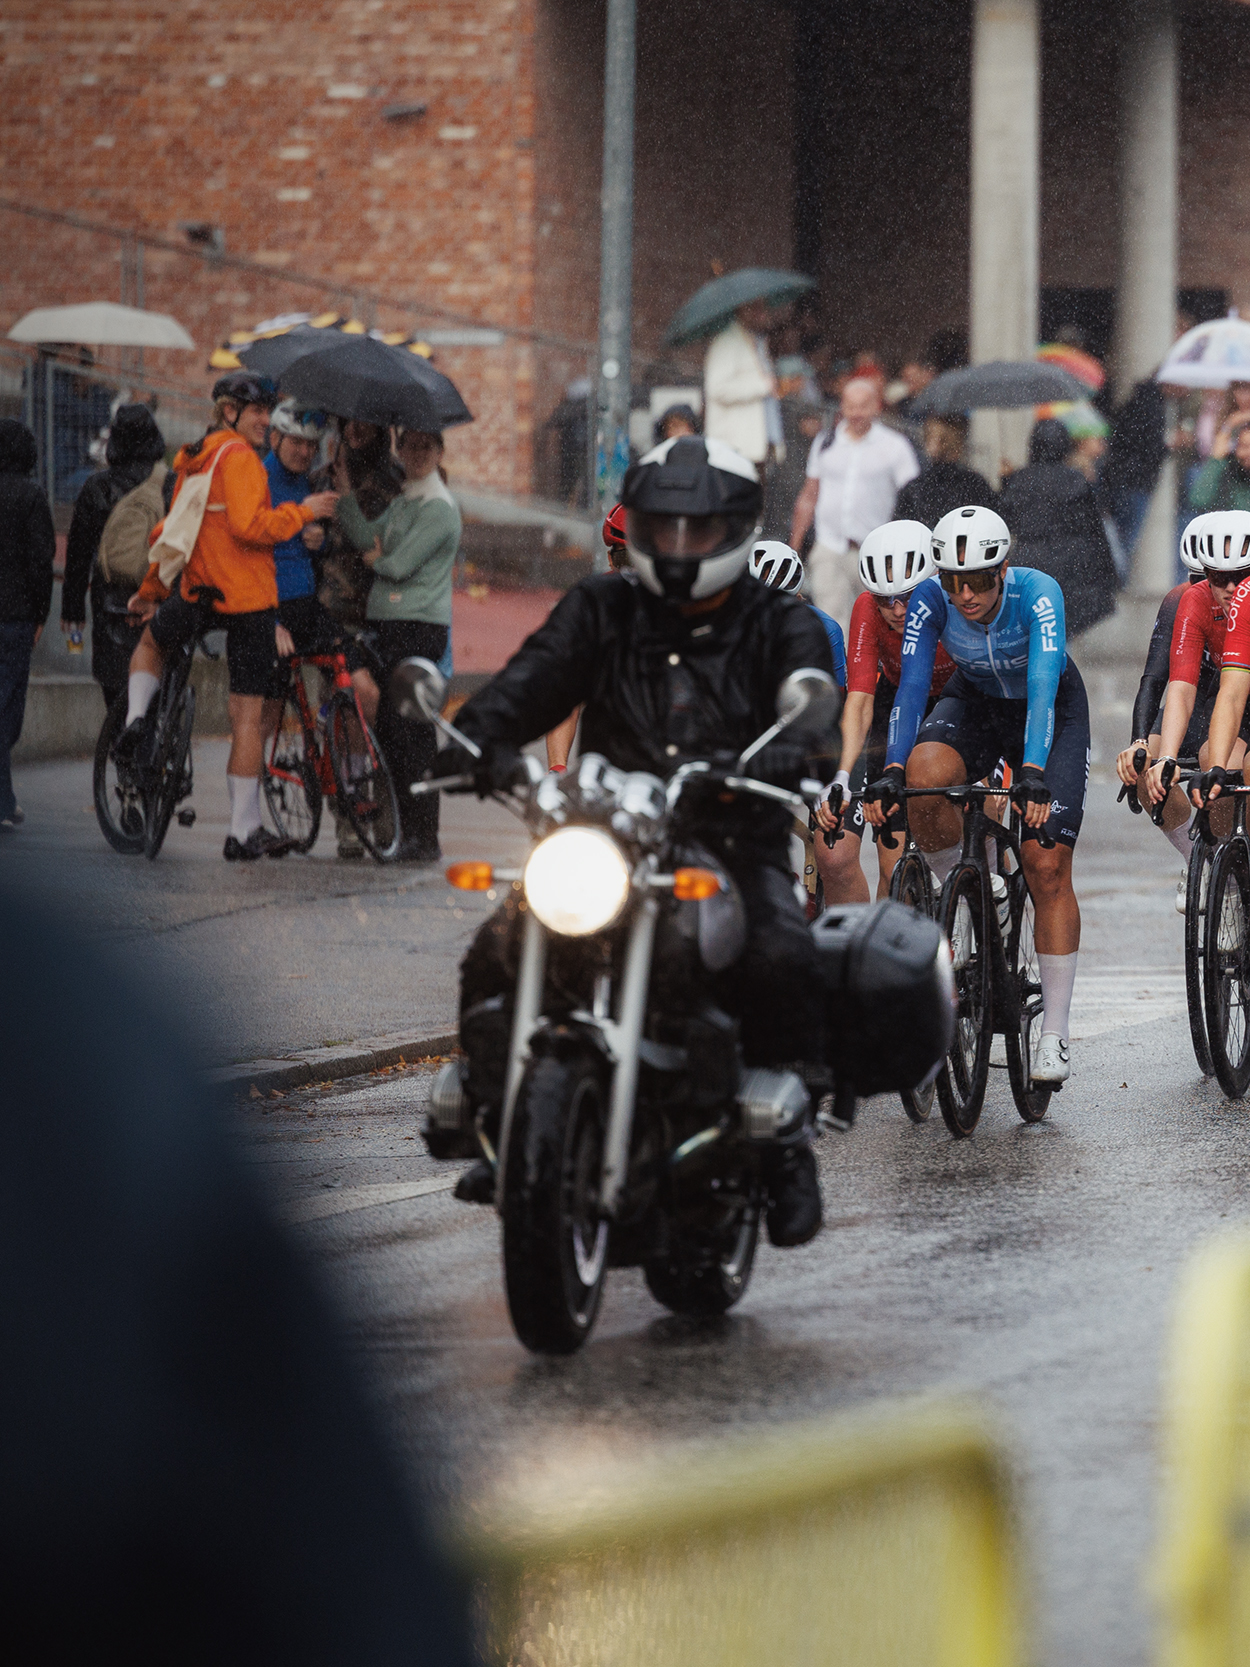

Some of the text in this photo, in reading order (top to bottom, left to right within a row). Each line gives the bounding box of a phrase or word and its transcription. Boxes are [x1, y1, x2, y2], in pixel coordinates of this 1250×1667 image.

[903, 600, 932, 656] FRIIS
[1032, 596, 1058, 652] FRIIS
[952, 653, 1028, 670] FRIIS
